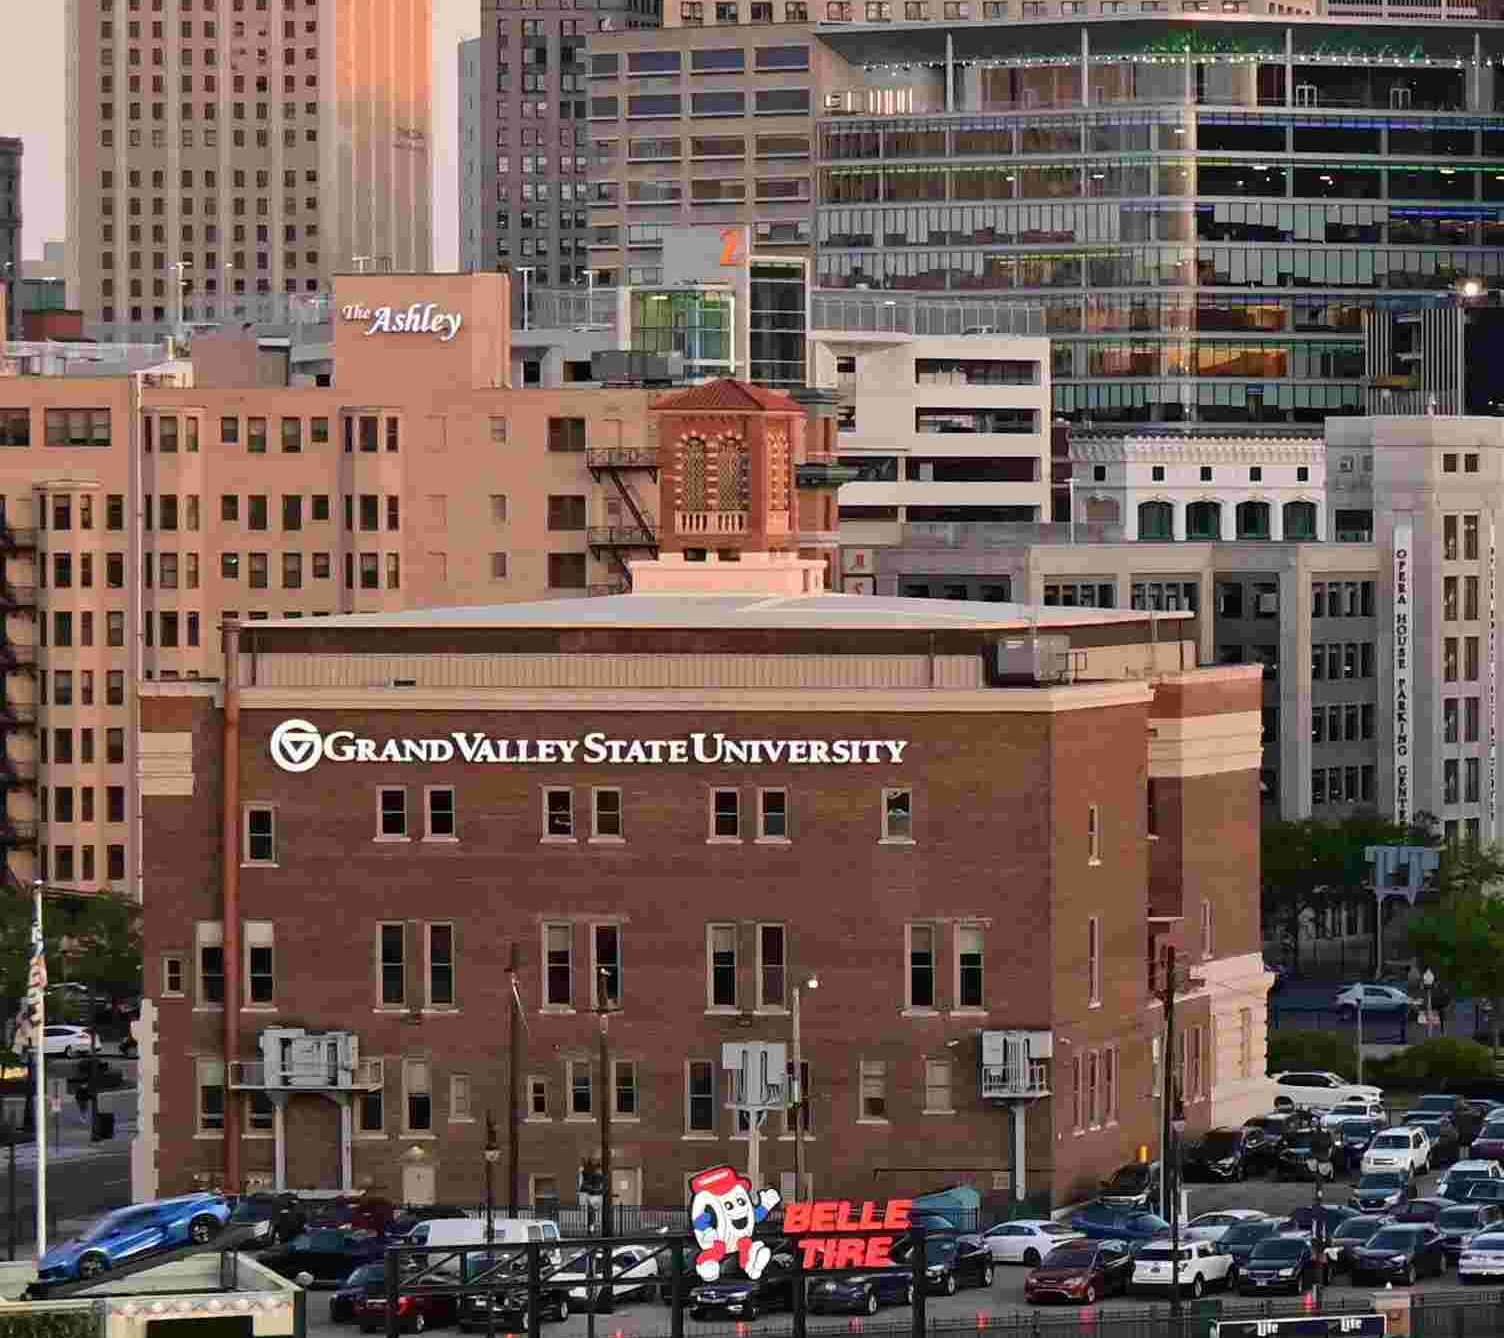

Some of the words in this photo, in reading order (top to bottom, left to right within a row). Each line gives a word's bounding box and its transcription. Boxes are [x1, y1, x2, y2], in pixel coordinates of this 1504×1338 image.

[343, 304, 371, 323] The
[368, 303, 463, 342] Ashley
[323, 731, 452, 764] GRAND
[452, 732, 576, 763] VALLEY
[584, 733, 690, 764] STATE
[691, 734, 908, 764] UNIVERSITY
[783, 1197, 913, 1234] BELLE
[799, 1234, 896, 1271] TIRE
